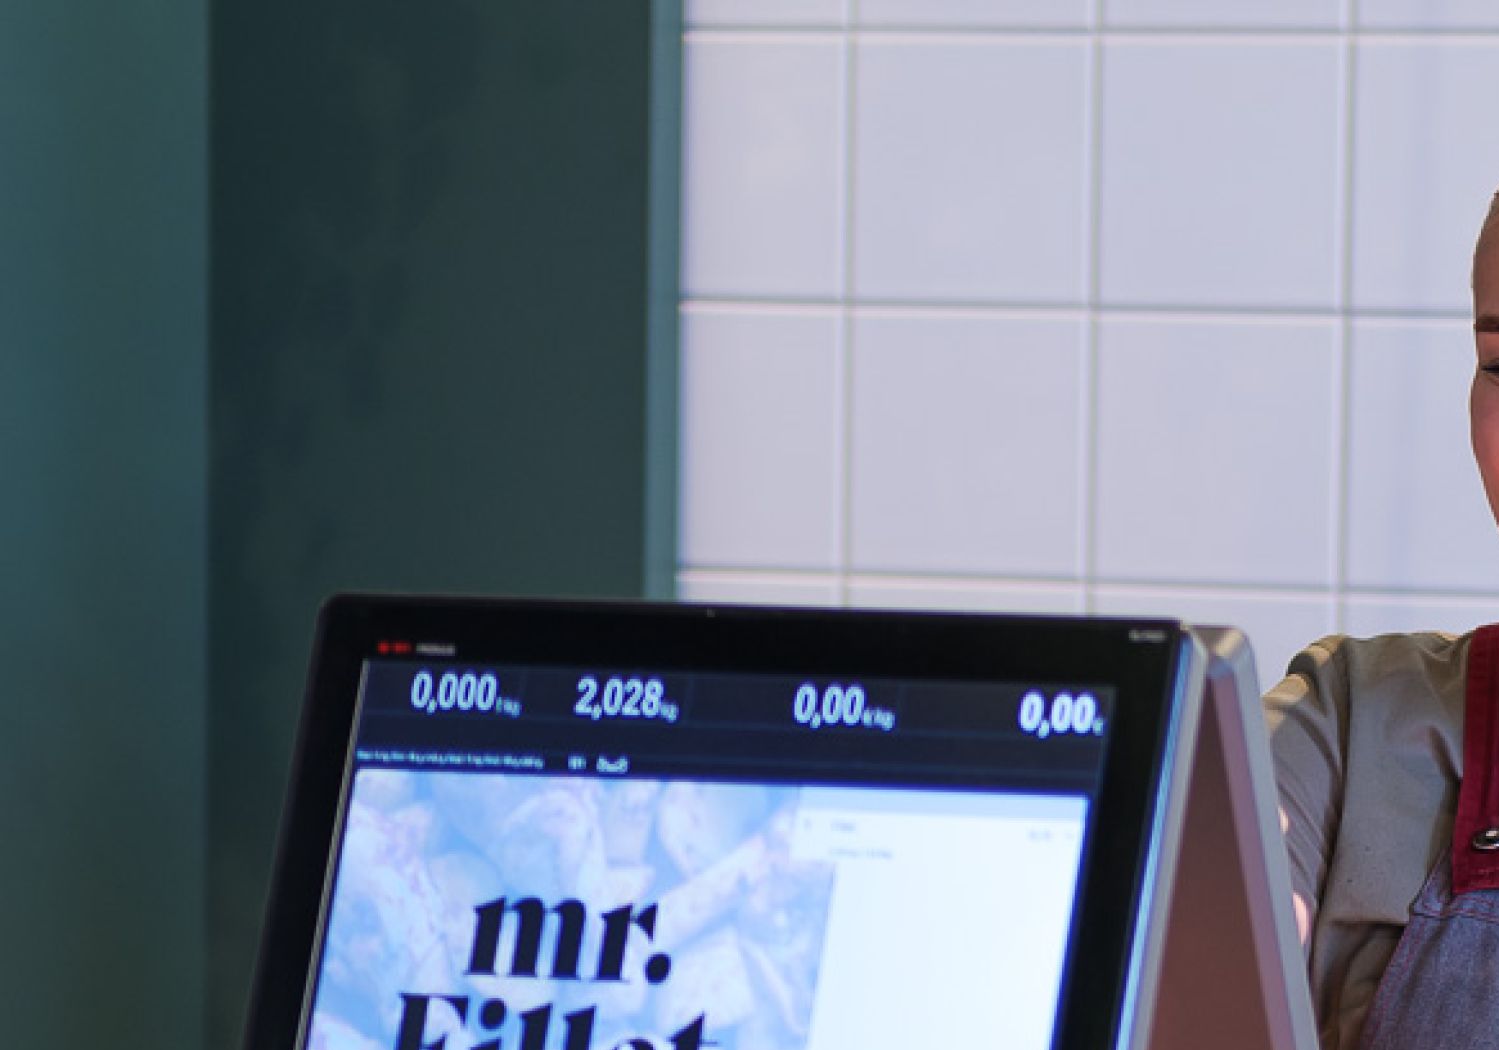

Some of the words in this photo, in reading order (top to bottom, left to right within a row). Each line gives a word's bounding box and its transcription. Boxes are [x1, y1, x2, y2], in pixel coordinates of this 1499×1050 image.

[411, 671, 497, 715] 0,000
[574, 675, 662, 721] 2,028
[793, 684, 865, 729] 0,00
[1019, 692, 1096, 739] 0,00
[464, 895, 673, 984] mr.
